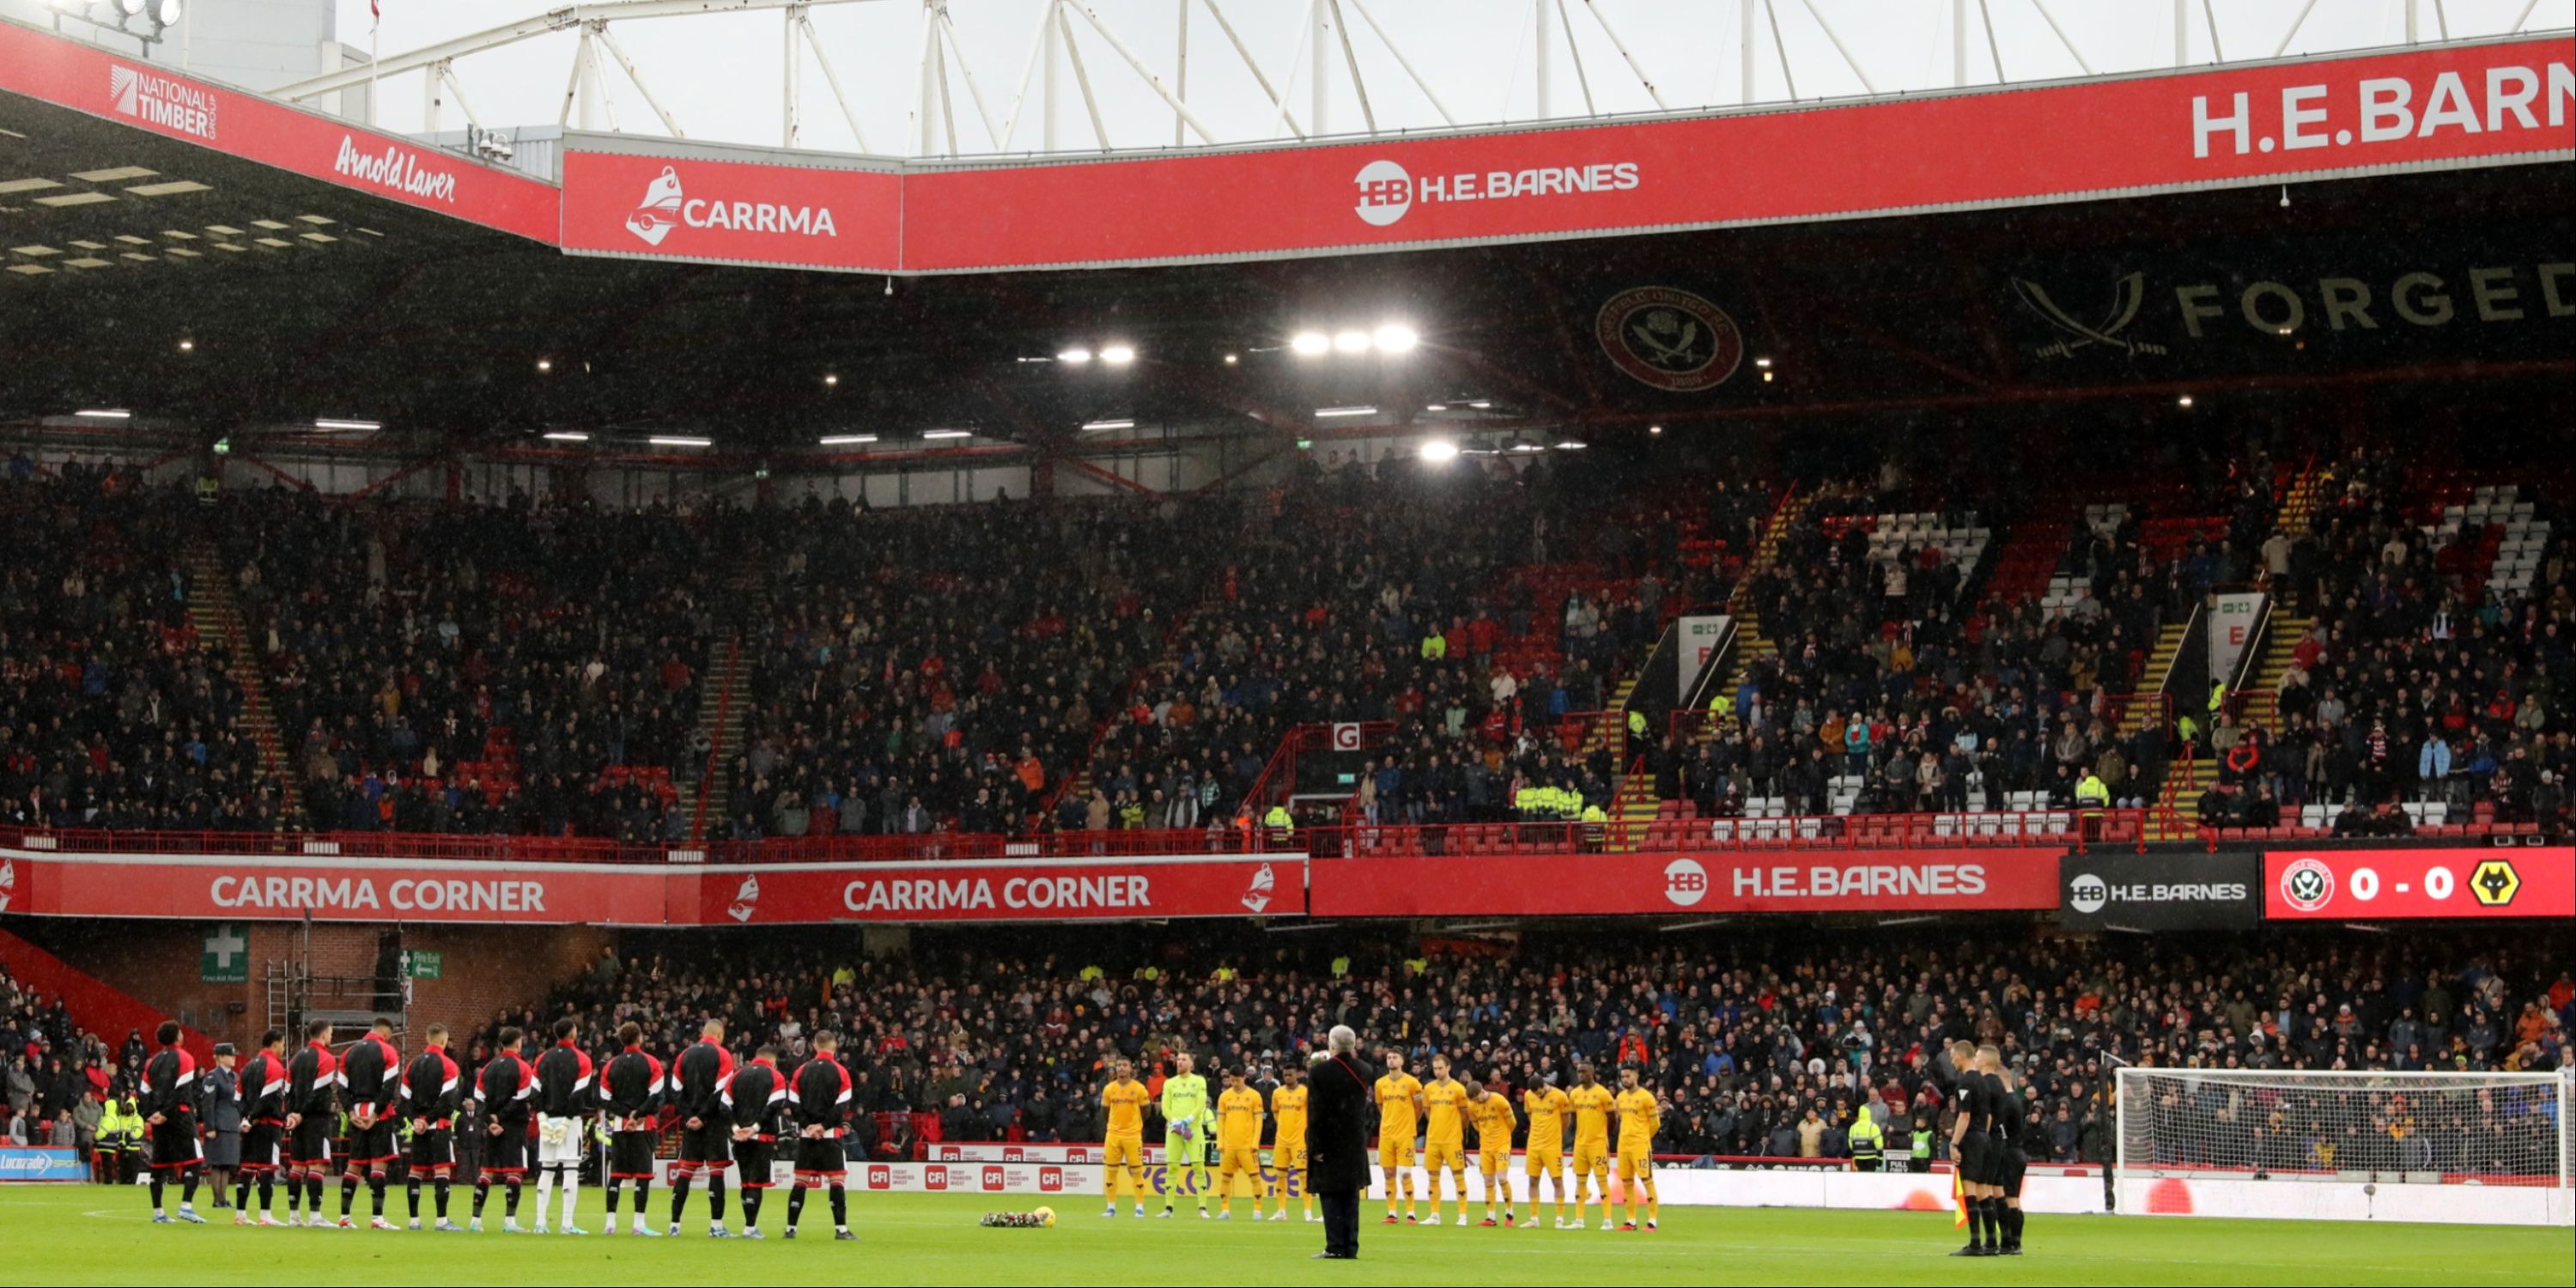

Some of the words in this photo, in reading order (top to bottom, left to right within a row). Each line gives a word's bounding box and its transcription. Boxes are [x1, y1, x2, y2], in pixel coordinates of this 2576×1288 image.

[139, 72, 208, 112] NATIONAL
[138, 94, 207, 137] TIMBER
[334, 134, 404, 190] Arnold
[404, 154, 455, 203] Laver
[1420, 162, 1639, 204] H.E.BARNES
[683, 198, 837, 237] CARRMA
[2229, 625, 2245, 646] E
[1337, 725, 1358, 748] G
[211, 875, 380, 908] CARRMA
[389, 878, 545, 911] CORNER
[844, 878, 996, 912] CARRMA
[1004, 875, 1151, 909] CORNER
[1733, 864, 1986, 896] H.E.BARNES
[2111, 883, 2247, 902] H.E.BARNES
[2349, 867, 2379, 901] 0
[2424, 866, 2454, 900] 0
[871, 1171, 888, 1183] CFI
[928, 1172, 945, 1183] CFI
[985, 1172, 1001, 1184] CFI
[1042, 1173, 1059, 1185] CFI
